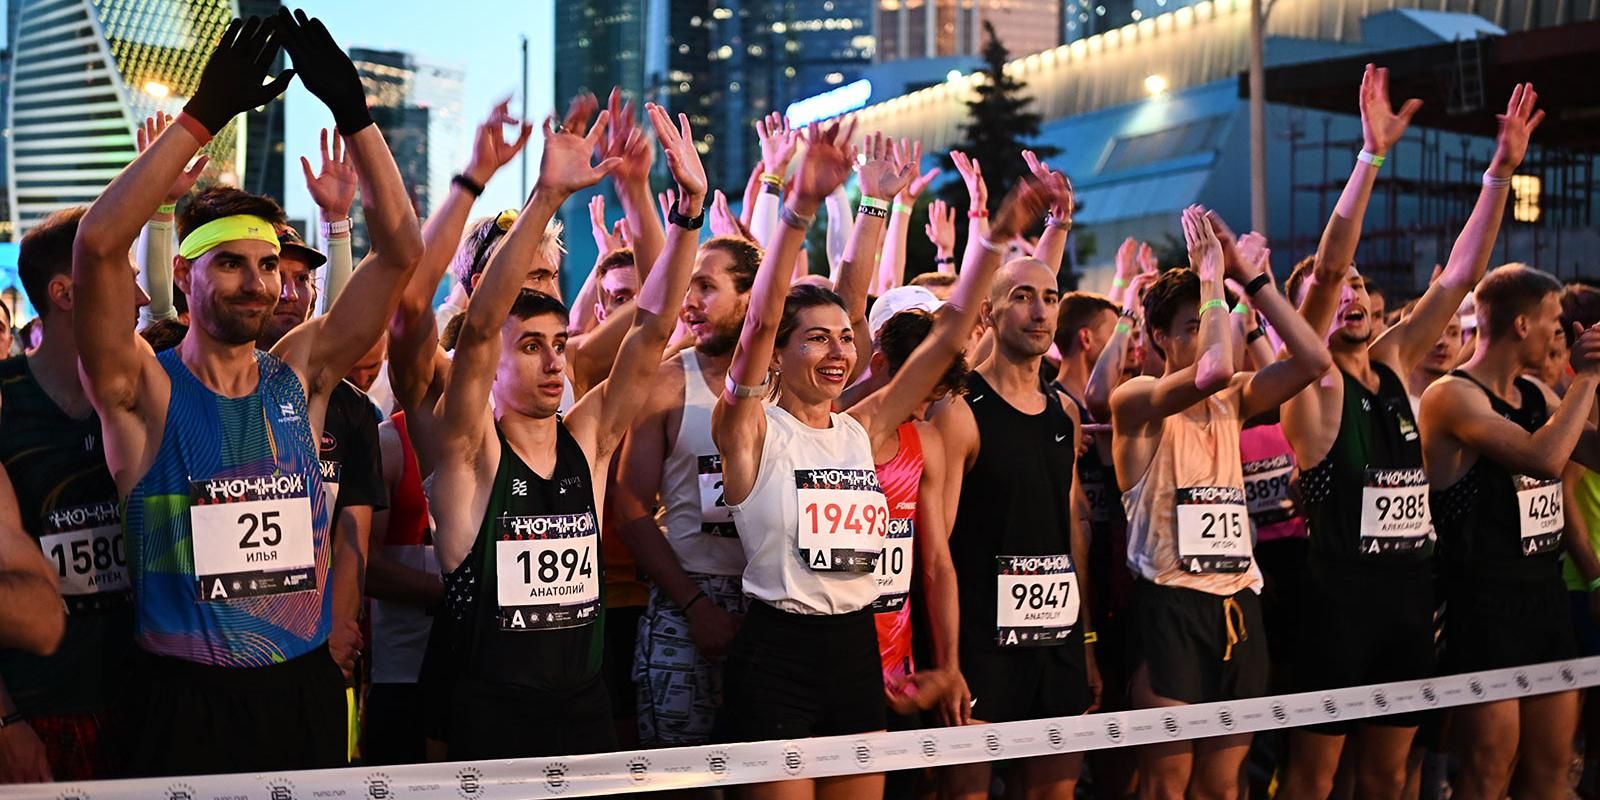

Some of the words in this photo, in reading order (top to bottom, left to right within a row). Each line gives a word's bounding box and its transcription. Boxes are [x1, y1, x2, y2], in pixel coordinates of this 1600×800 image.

[805, 503, 886, 537] 19493
[1376, 494, 1424, 521] 9385
[237, 511, 282, 549] 25
[1201, 513, 1241, 538] 215
[51, 534, 127, 577] 1580
[246, 550, 278, 563] ИЛЬЯ
[517, 546, 592, 584] 1894
[530, 583, 585, 598] АНАТОЛИЙ
[1012, 581, 1070, 610] 9847
